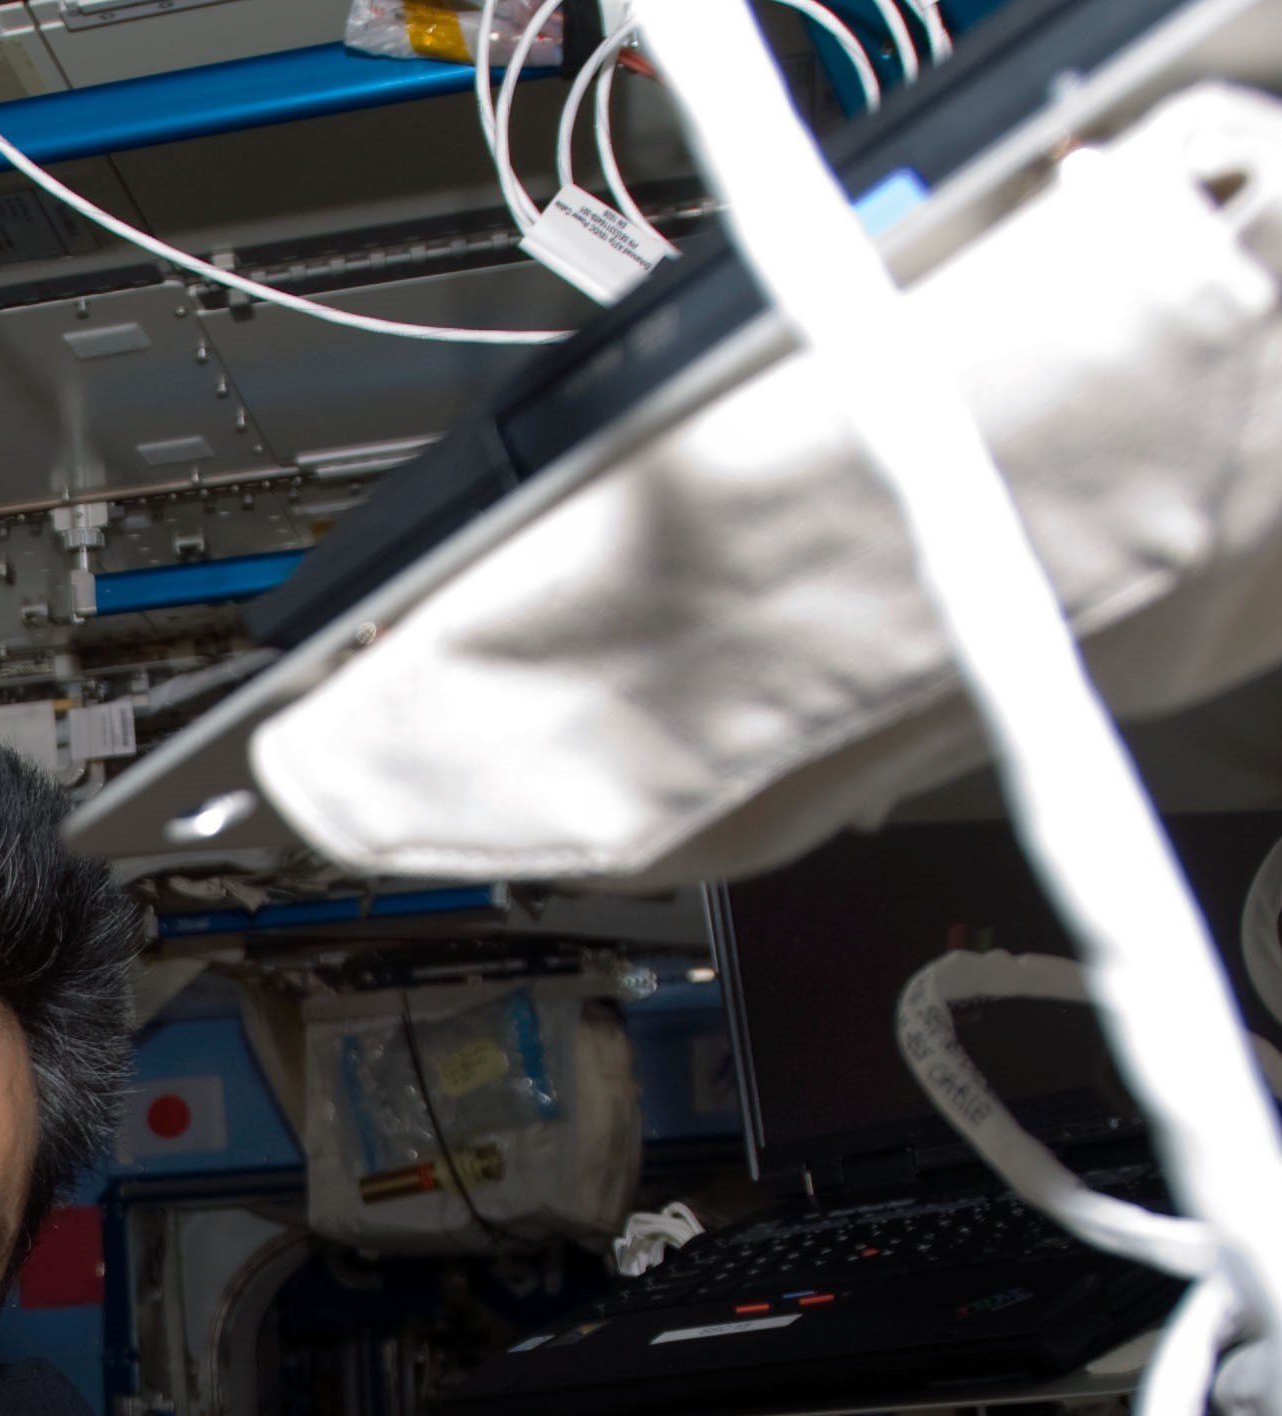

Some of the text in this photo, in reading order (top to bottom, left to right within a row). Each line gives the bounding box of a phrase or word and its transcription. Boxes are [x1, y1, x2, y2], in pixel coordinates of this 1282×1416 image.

[556, 200, 572, 214] Cable
[572, 213, 590, 227] Power
[618, 219, 628, 229] SN
[628, 239, 639, 250] PN
